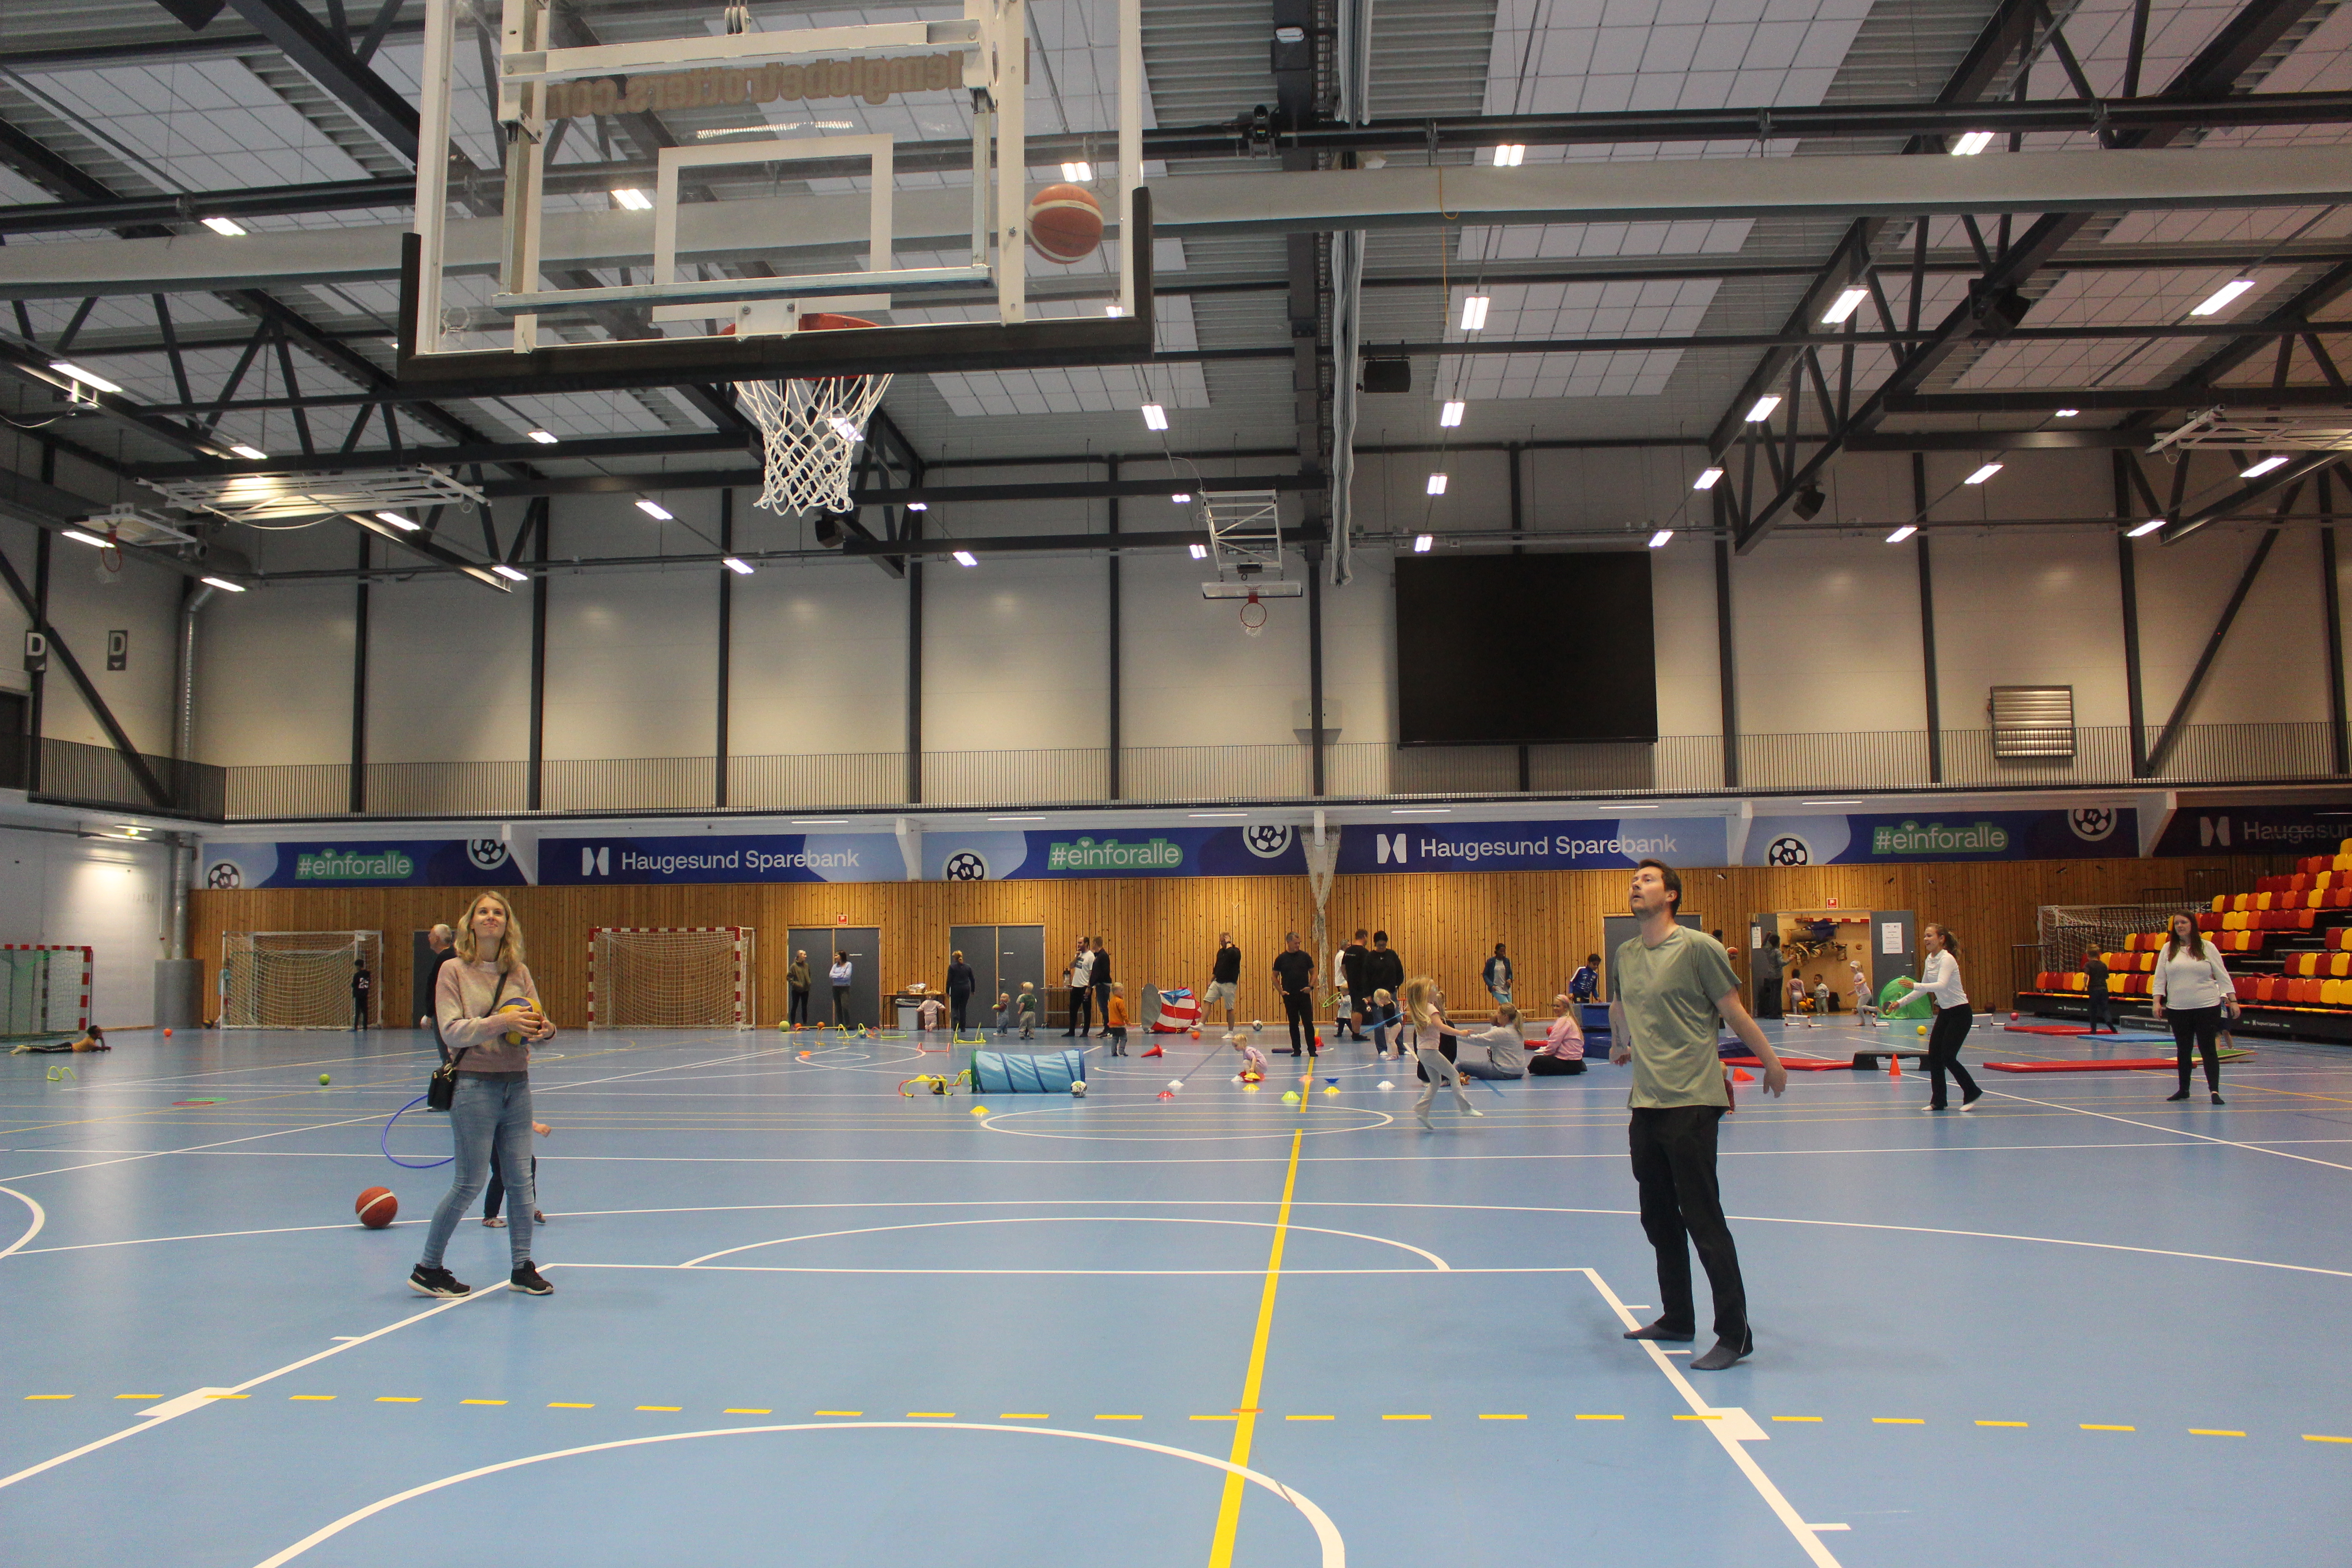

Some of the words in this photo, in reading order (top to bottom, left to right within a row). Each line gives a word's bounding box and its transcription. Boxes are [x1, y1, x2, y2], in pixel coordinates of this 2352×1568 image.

[26, 632, 46, 657] D
[109, 632, 126, 656] D
[1421, 836, 1548, 861] Haugesund
[1555, 834, 1677, 859] Sparebank
[1876, 825, 2004, 850] #einforalle
[299, 853, 410, 876] #einforalle
[622, 851, 739, 874] Haugesund
[745, 849, 859, 873] Sparebank
[1052, 841, 1179, 866] #einforalle
